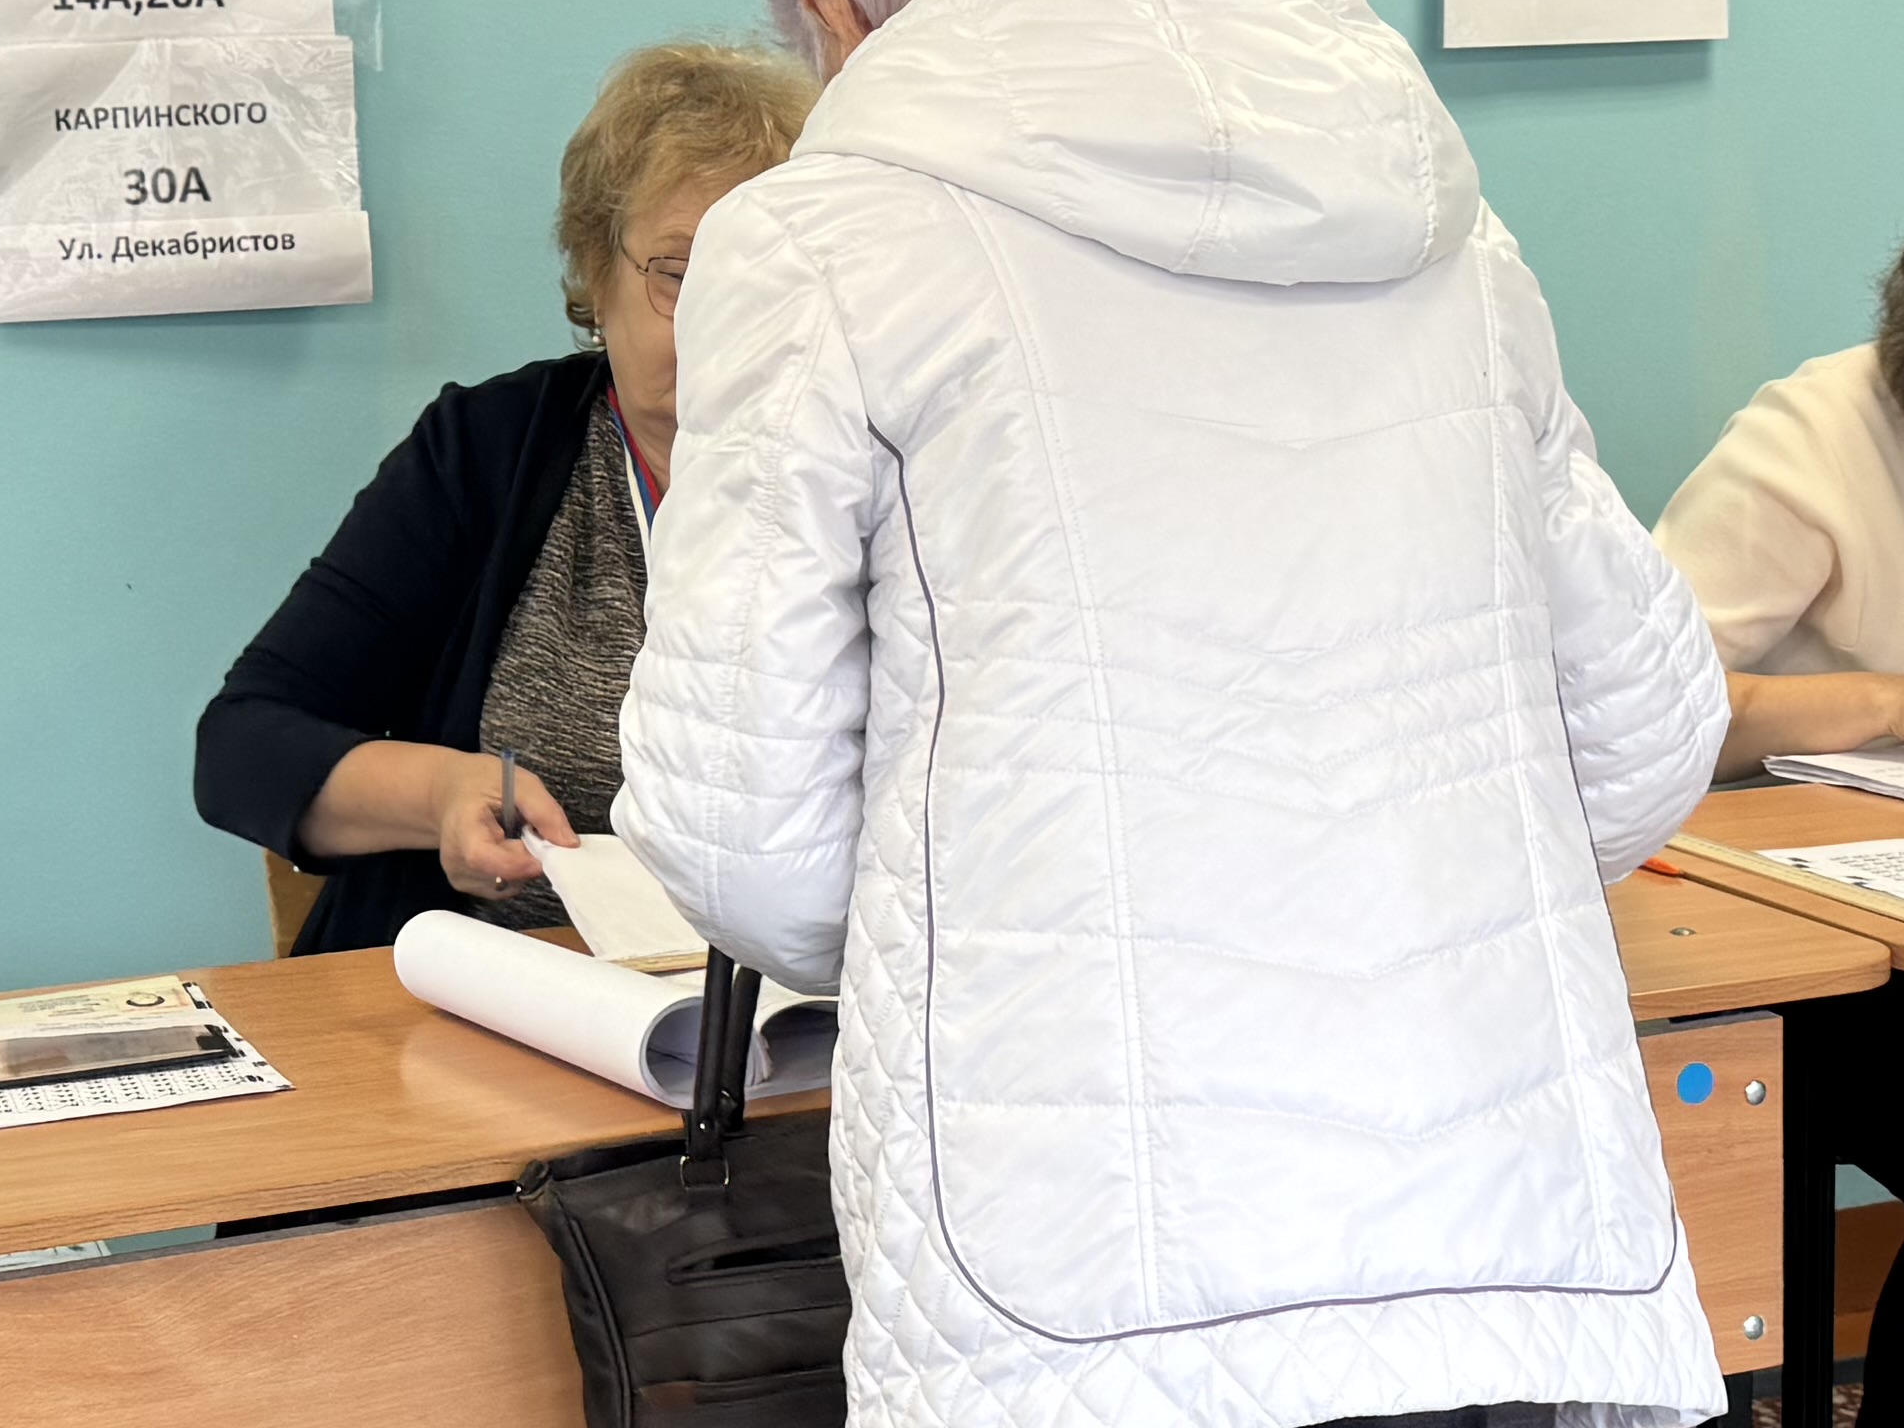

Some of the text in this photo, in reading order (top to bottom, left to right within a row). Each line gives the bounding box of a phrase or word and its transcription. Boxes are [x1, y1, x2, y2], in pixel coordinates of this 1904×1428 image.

[53, 101, 268, 133] КАРПИНСКОГО
[123, 165, 213, 207] 30А
[57, 229, 297, 264] Ул. Декабристов
